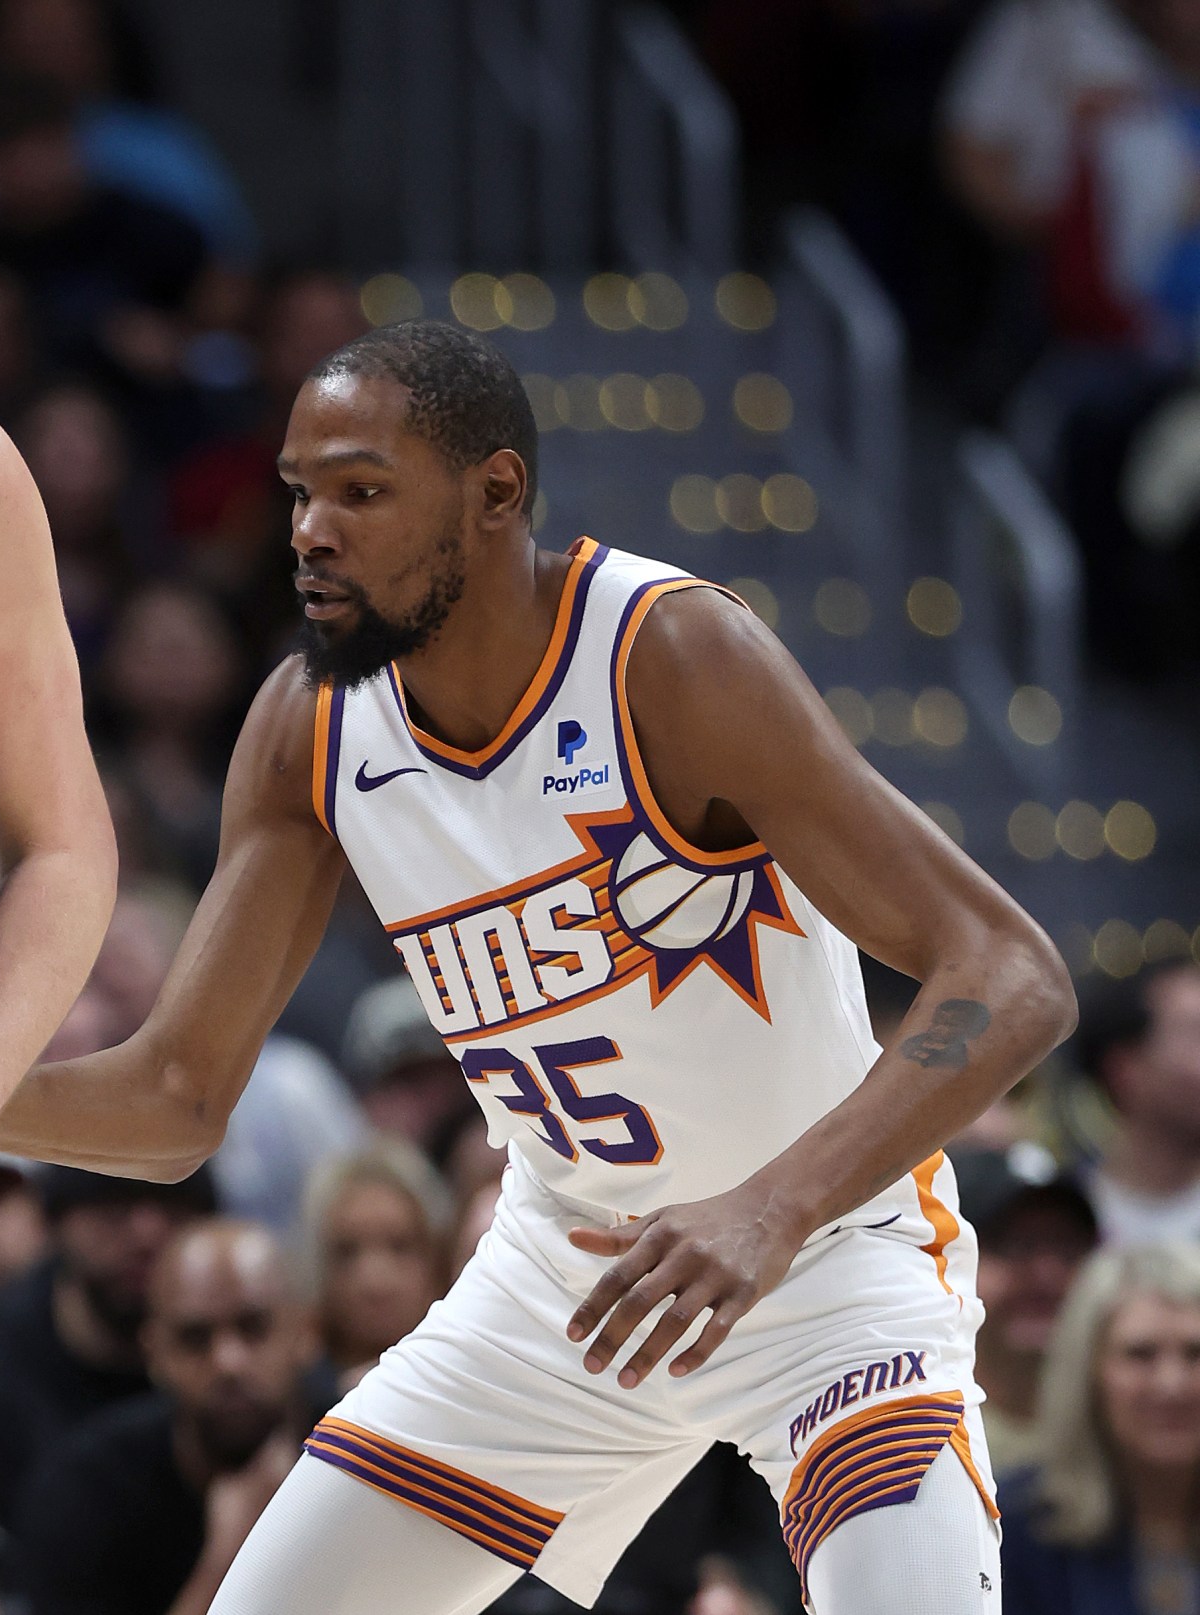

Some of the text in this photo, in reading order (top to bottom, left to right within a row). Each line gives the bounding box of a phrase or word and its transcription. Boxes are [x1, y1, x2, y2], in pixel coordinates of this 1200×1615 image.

[542, 764, 609, 795] PayPal
[393, 877, 614, 1036] UNS
[460, 1035, 665, 1166] 35
[789, 1350, 927, 1460] PHOENIX
